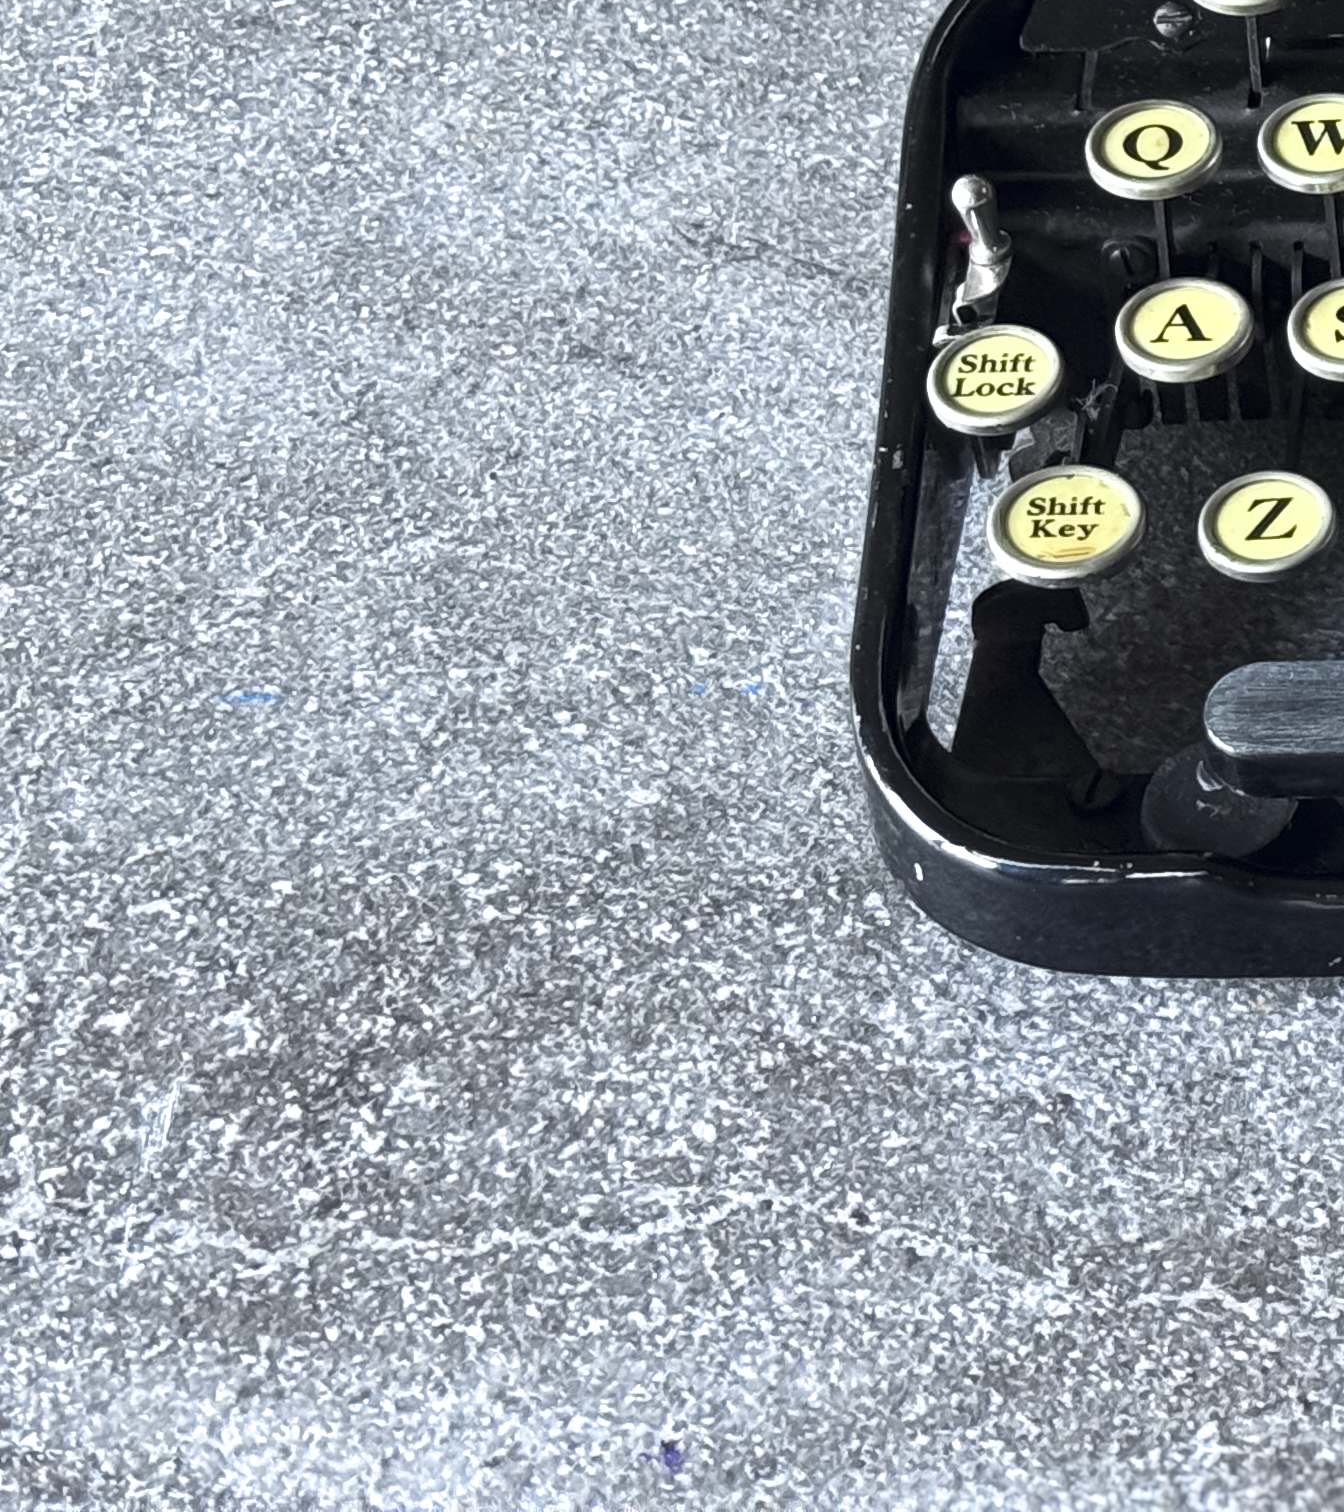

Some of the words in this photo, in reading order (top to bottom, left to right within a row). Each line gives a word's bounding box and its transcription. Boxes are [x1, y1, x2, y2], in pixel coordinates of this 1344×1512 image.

[1122, 123, 1184, 170] Q
[1150, 303, 1212, 344] A
[956, 352, 1036, 374] Shift
[951, 376, 1037, 398] Lock
[1026, 496, 1106, 517] Shift
[1029, 518, 1099, 542] Key
[1244, 497, 1297, 541] Z
